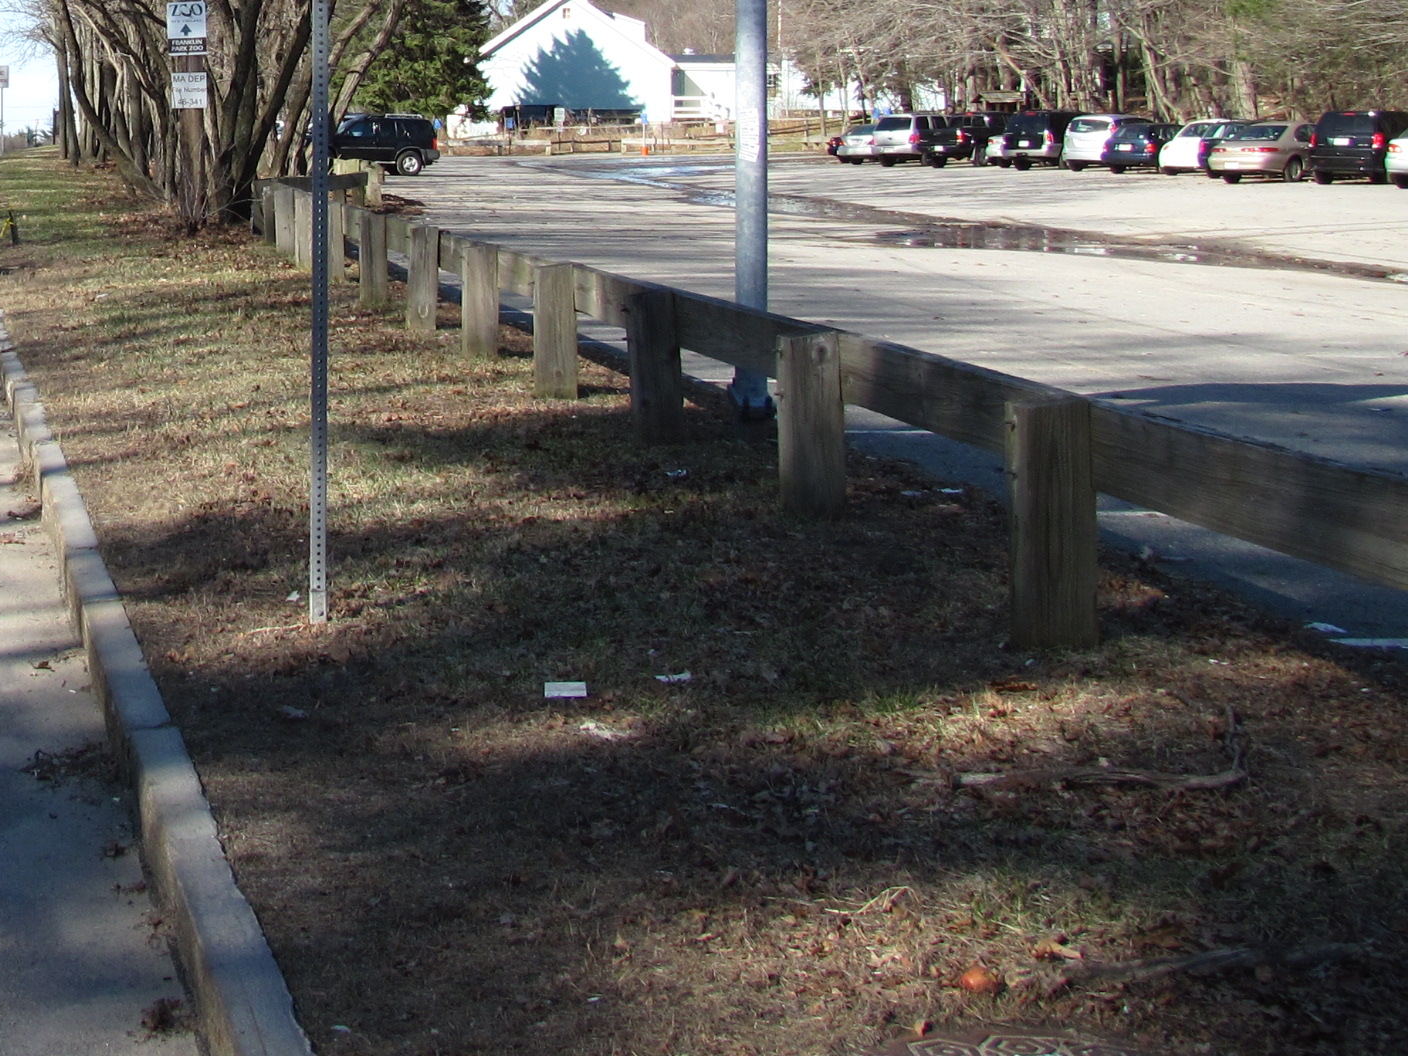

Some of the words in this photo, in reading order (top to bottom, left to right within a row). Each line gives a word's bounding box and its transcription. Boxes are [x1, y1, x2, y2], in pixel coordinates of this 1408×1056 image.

[169, 3, 203, 17] ZOO
[172, 38, 203, 46] FRANKLIN
[173, 75, 186, 83] MA
[187, 74, 205, 83] DEP
